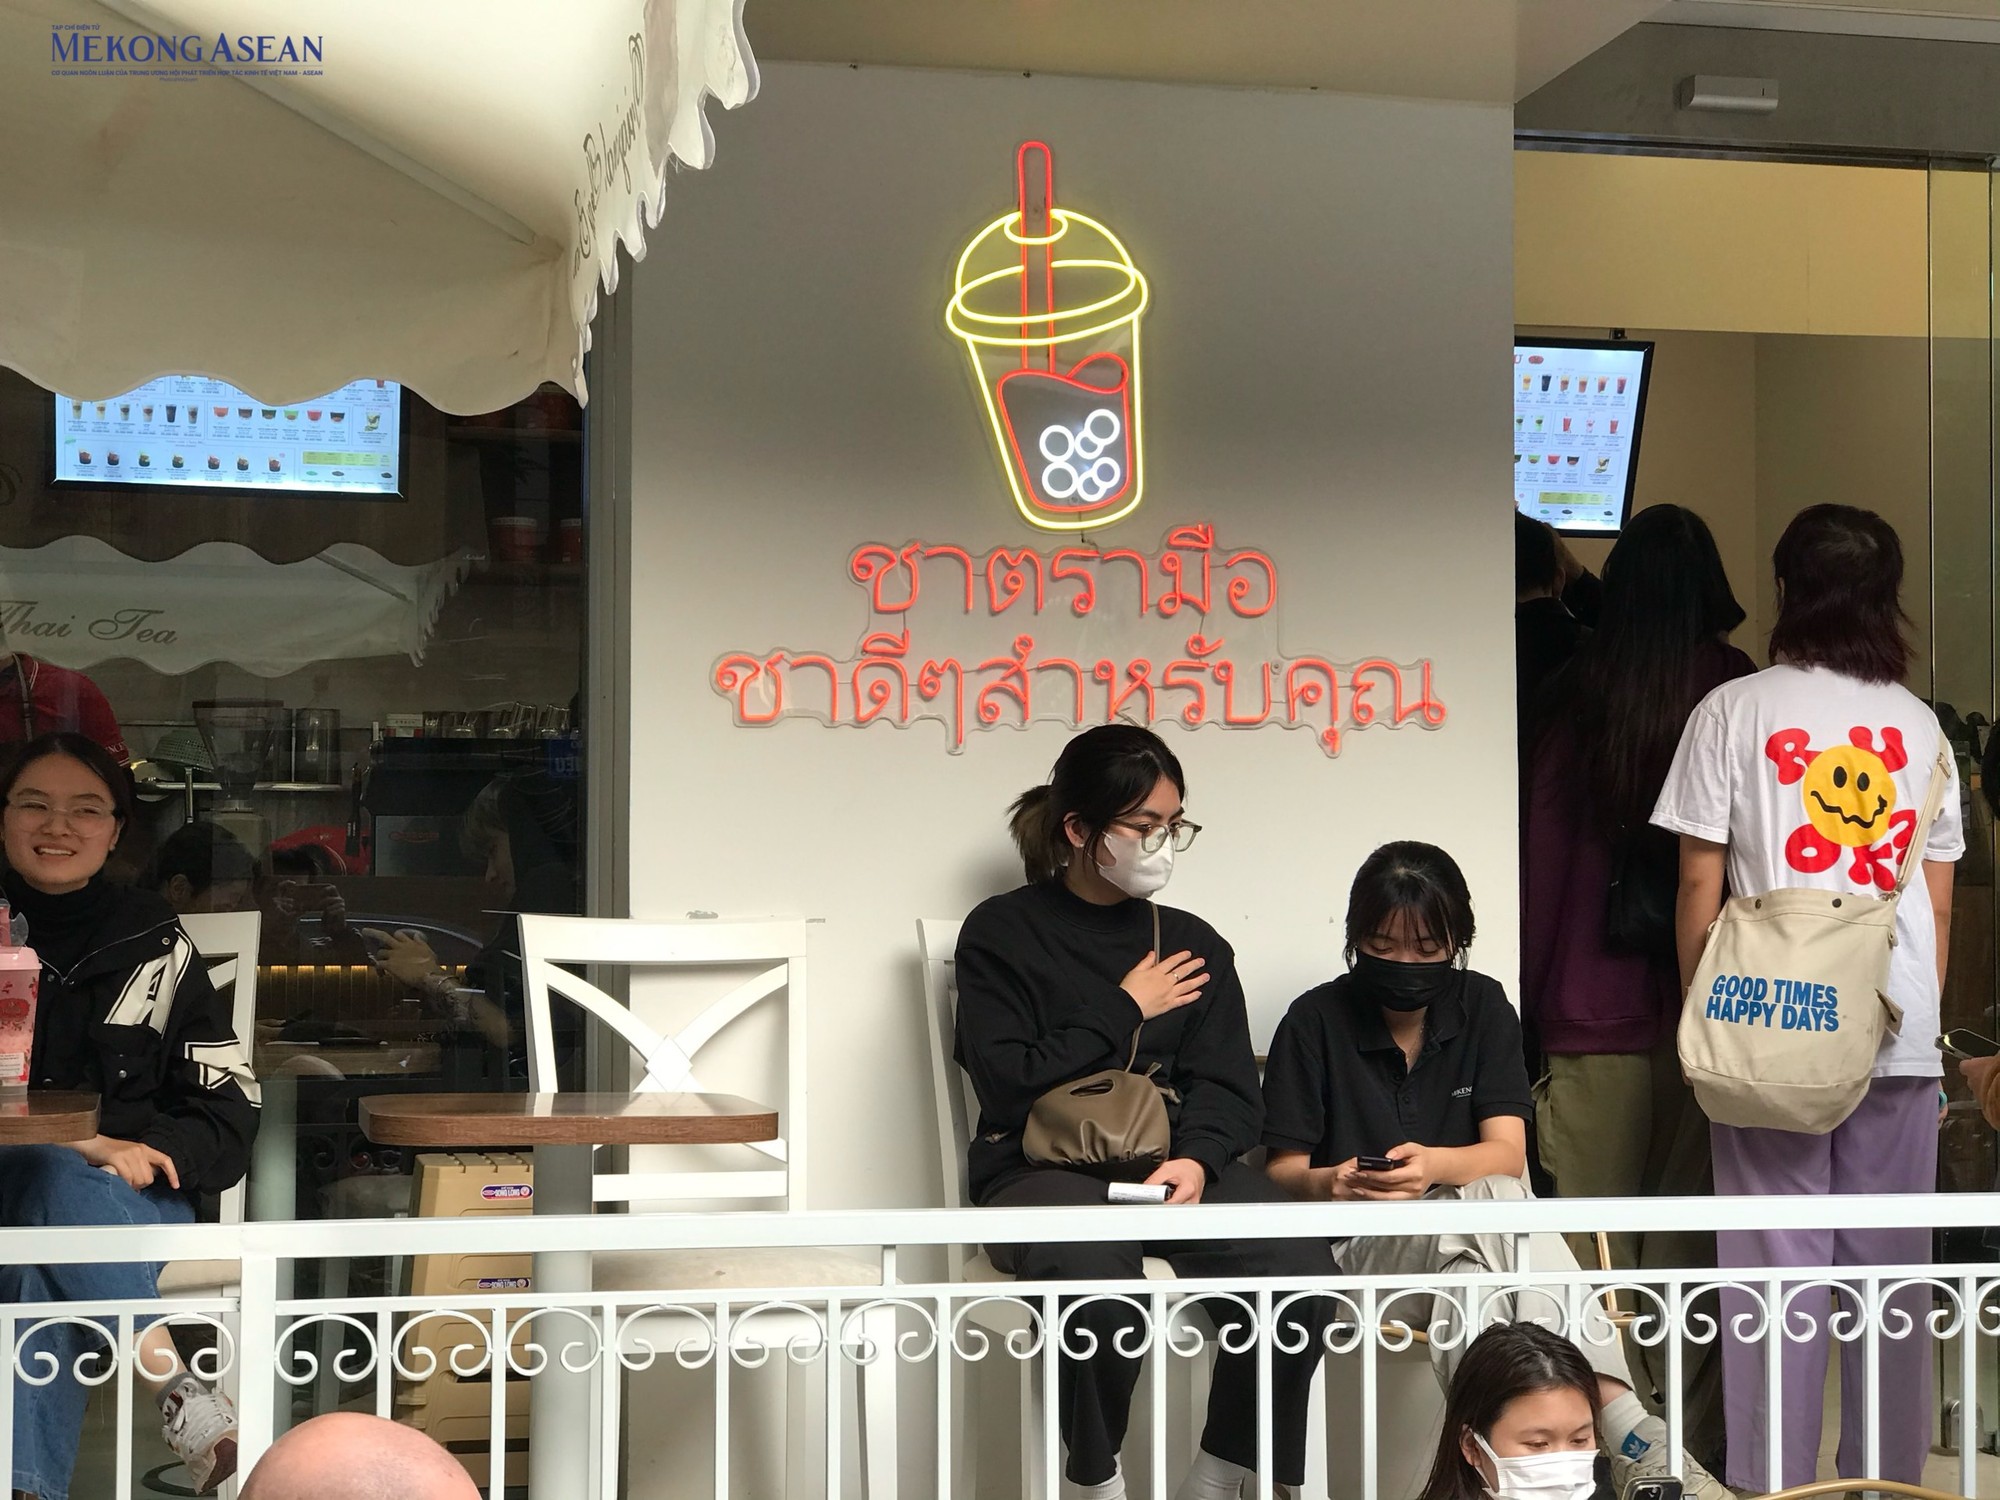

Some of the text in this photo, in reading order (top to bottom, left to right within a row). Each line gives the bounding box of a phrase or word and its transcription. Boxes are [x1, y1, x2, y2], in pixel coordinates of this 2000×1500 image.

[853, 523, 1277, 618] ชาตรามือ
[0, 600, 178, 645] Thai Tea
[714, 629, 1448, 755] ชาดีๆสำหรับคุณ
[1705, 995, 1840, 1033] HAPPY DAYS
[1711, 974, 1838, 1010] GOOD TIMES
